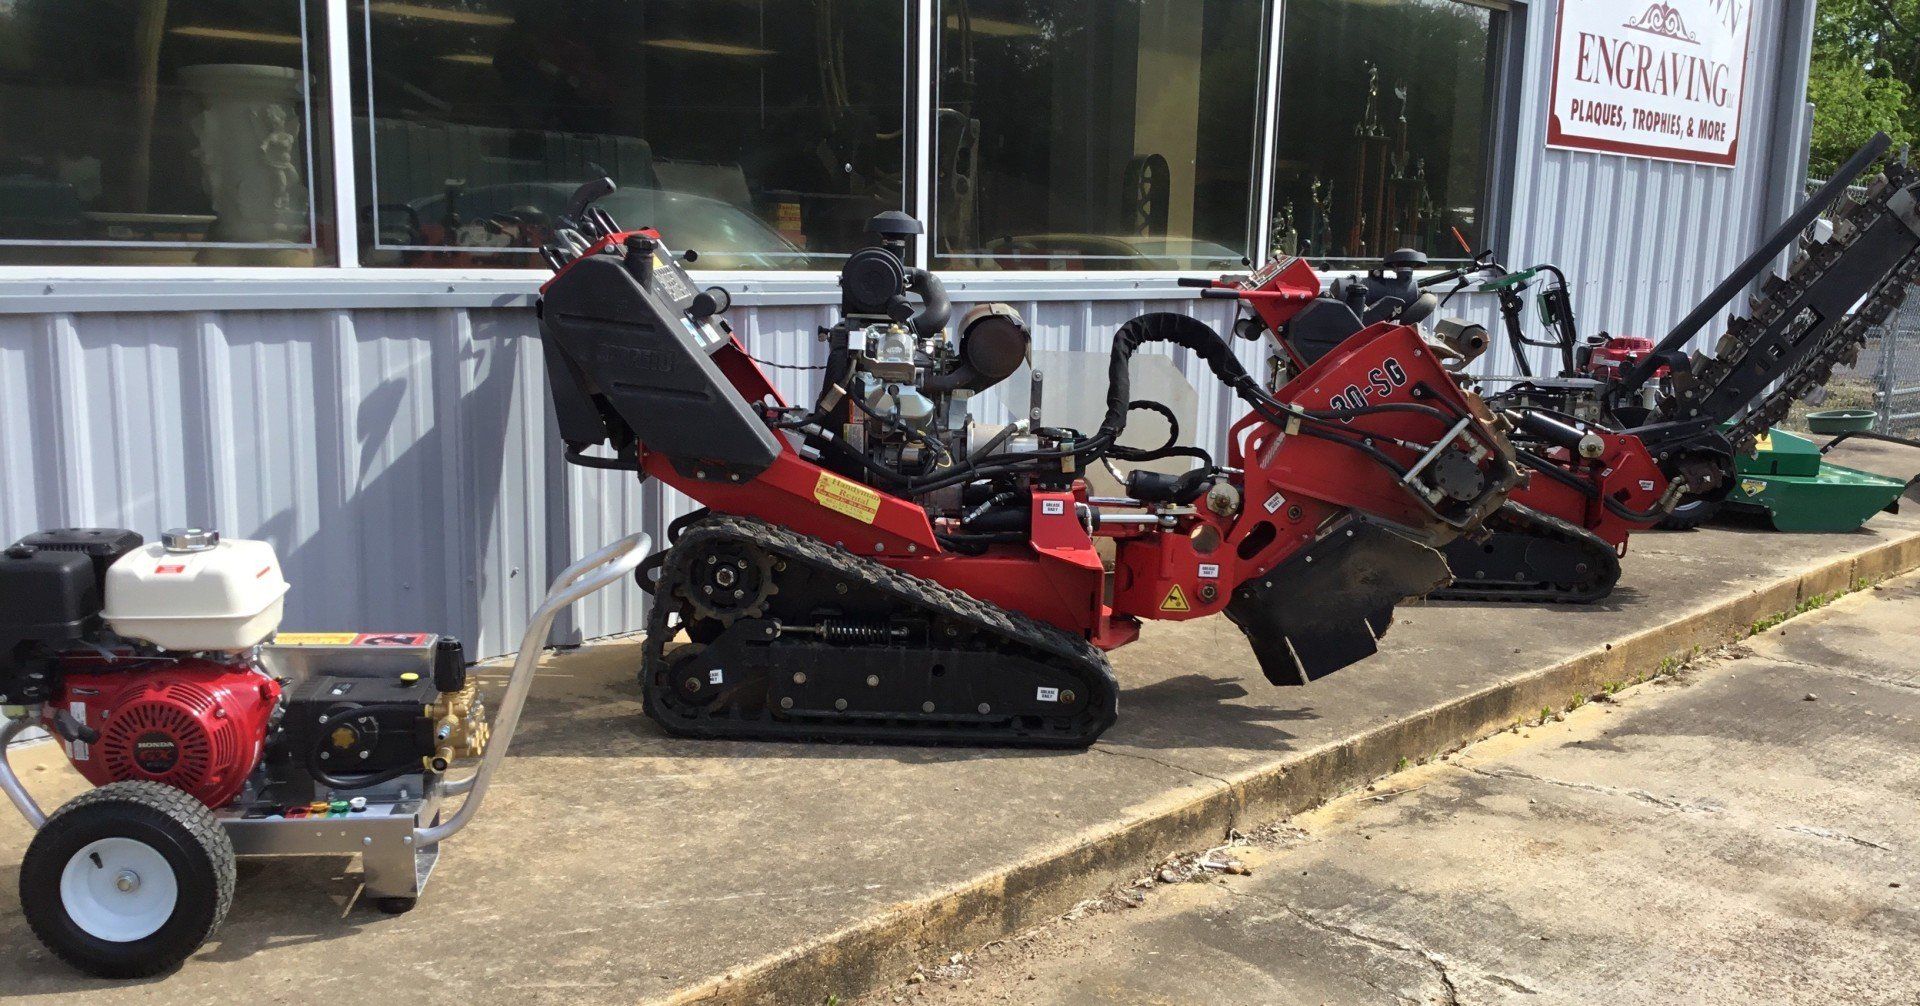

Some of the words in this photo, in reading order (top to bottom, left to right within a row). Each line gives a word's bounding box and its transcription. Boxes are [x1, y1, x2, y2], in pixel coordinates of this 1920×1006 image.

[1575, 31, 1729, 107] ENGRAVING
[1570, 98, 1627, 131] PLAQUES,
[1632, 108, 1683, 140] TROPHIES,
[1686, 117, 1694, 137] &
[1697, 119, 1727, 142] MORE
[1330, 357, 1407, 424] 30-SG
[832, 478, 879, 501] Handyman
